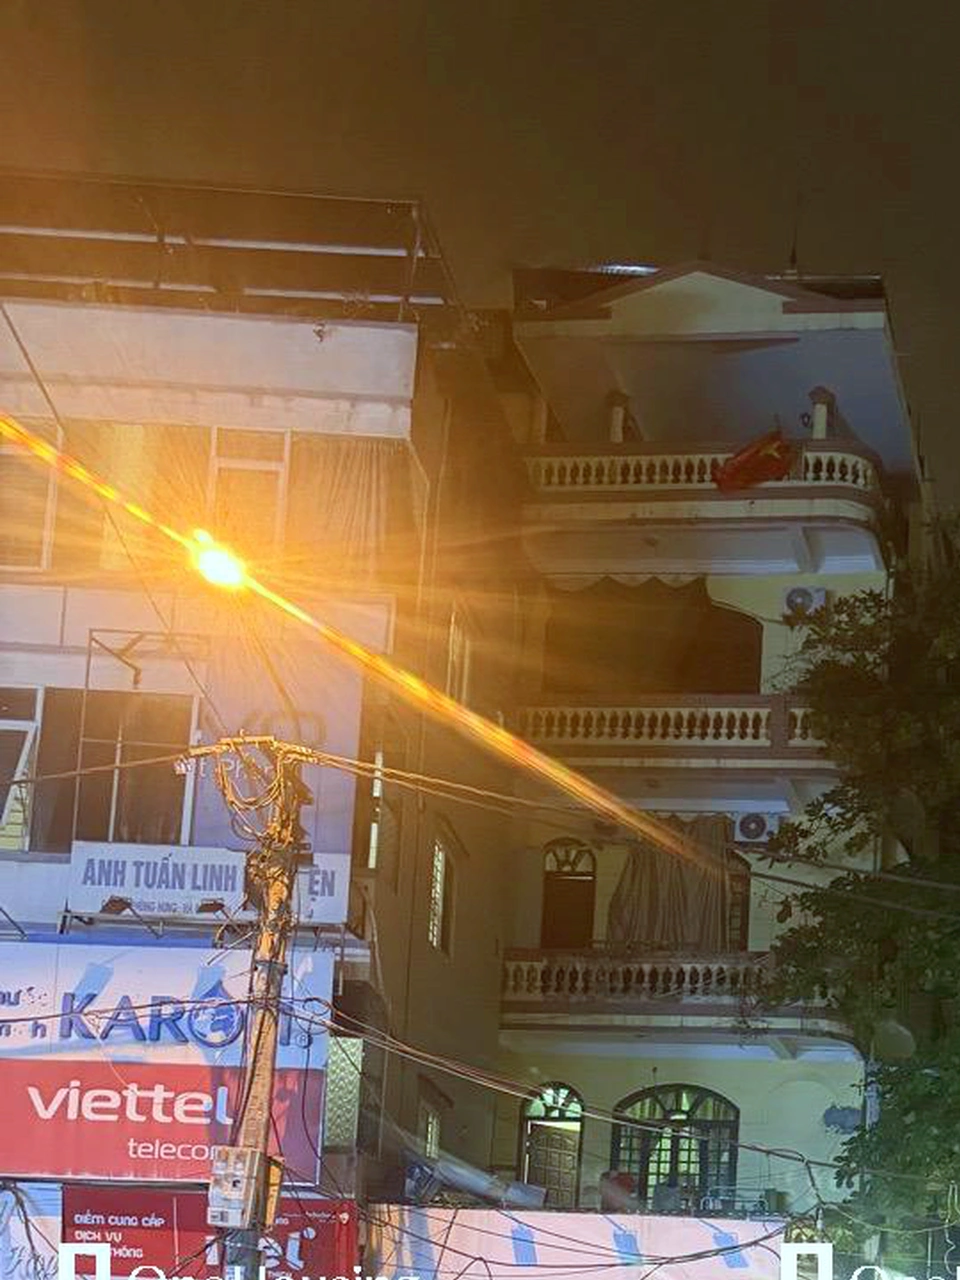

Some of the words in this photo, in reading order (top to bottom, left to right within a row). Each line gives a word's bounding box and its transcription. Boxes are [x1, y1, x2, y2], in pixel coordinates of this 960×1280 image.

[82, 858, 127, 888] ANH
[132, 852, 185, 890] TUẤN
[191, 863, 238, 892] LINH
[27, 1080, 234, 1125] viettel
